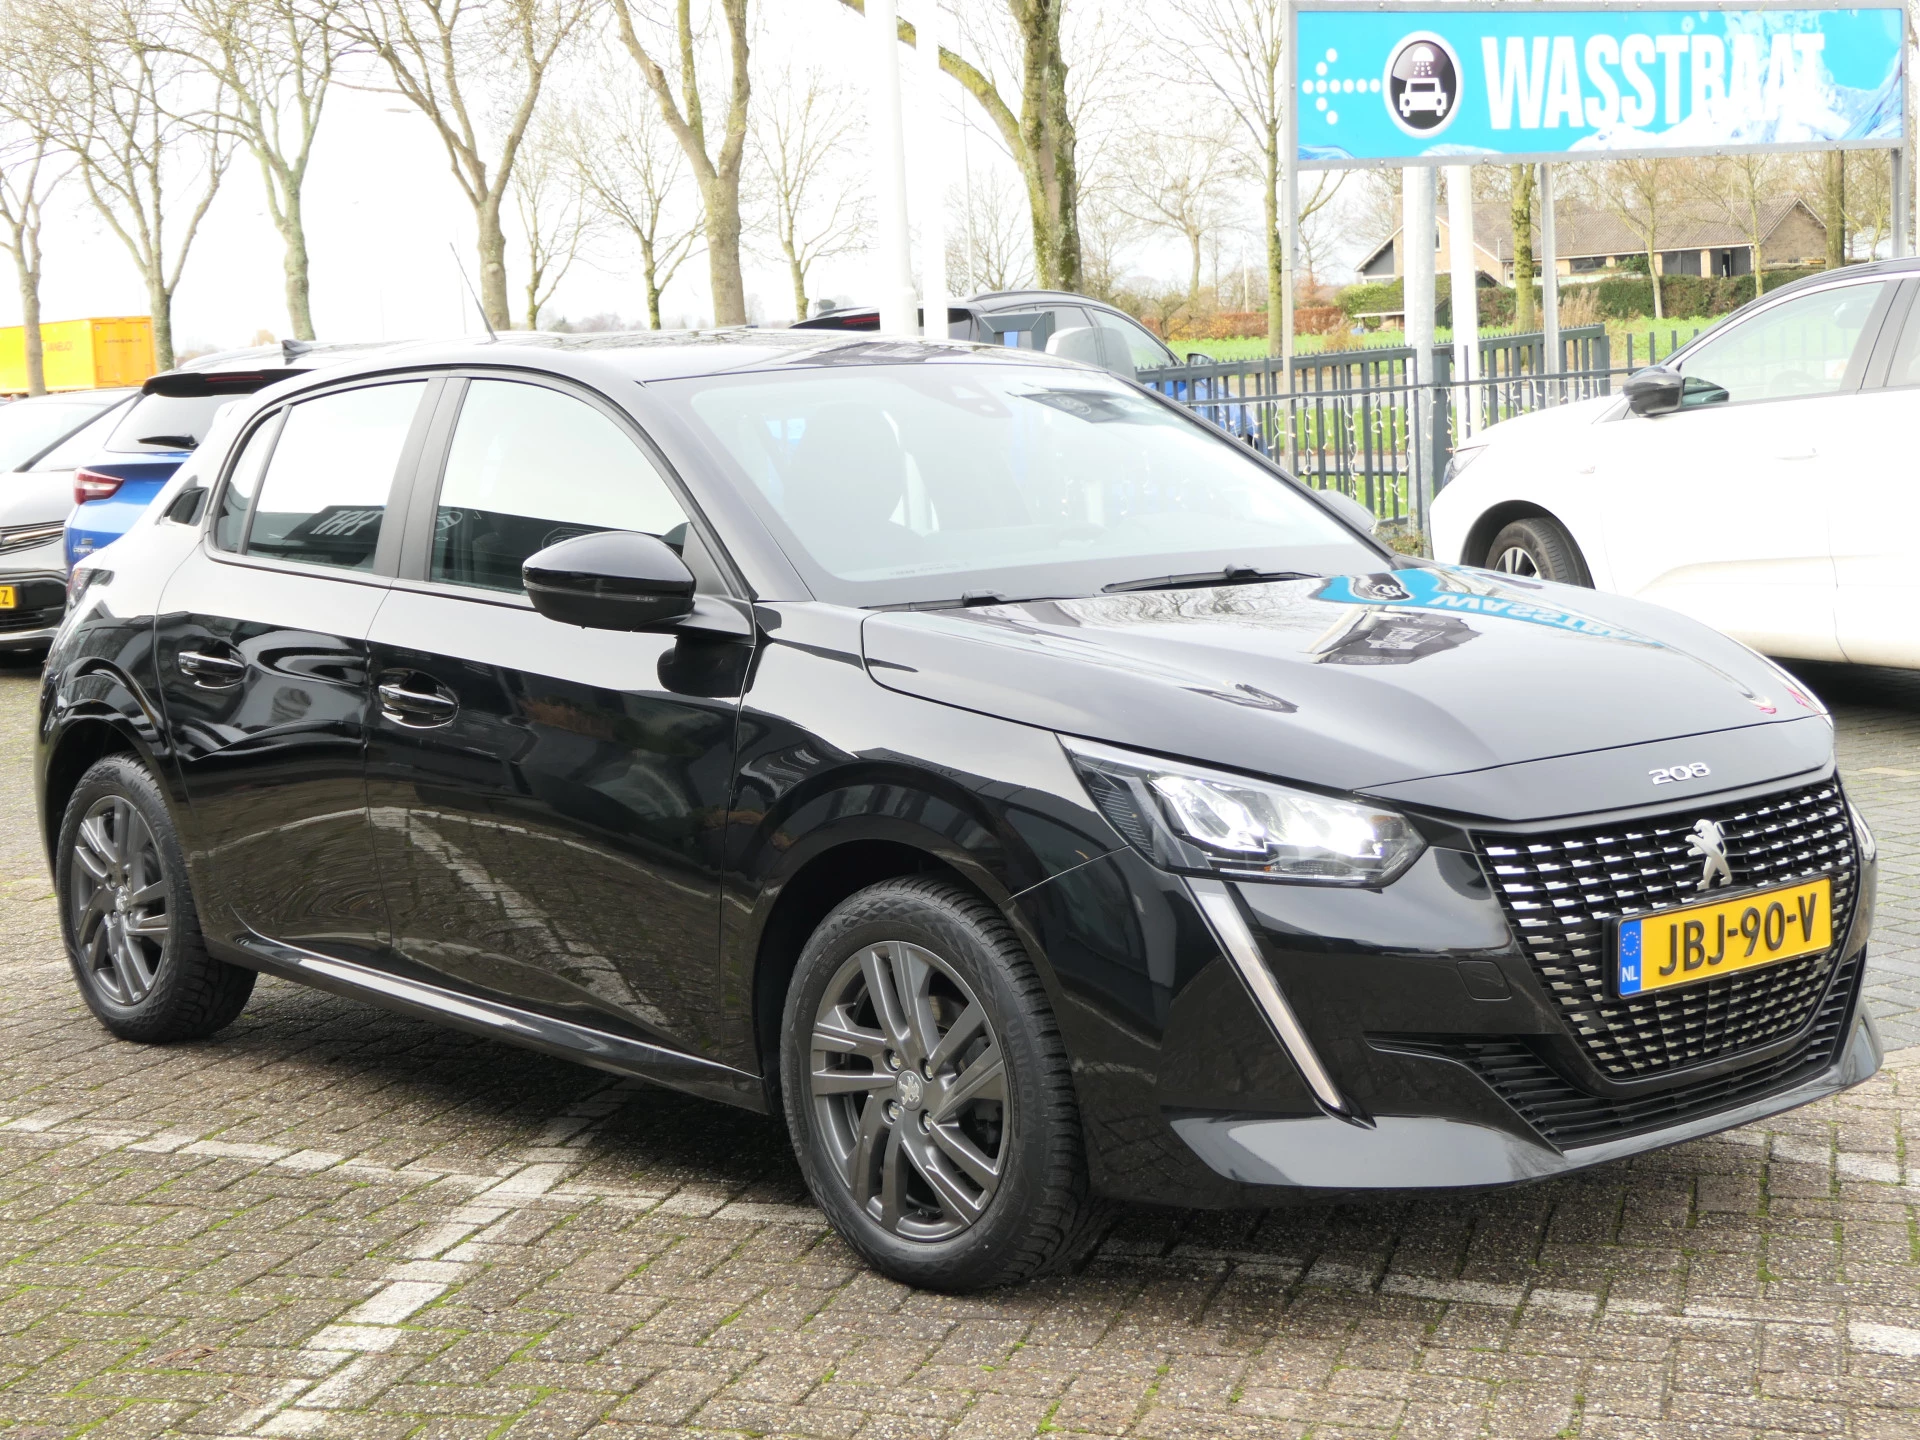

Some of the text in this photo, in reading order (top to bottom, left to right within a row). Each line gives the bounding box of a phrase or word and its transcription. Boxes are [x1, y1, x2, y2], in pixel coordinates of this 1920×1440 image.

[1481, 33, 1825, 130] WASSTRAAT
[1648, 762, 1711, 785] 208
[1658, 892, 1817, 977] JBJ-90-V
[1621, 966, 1639, 983] NL
